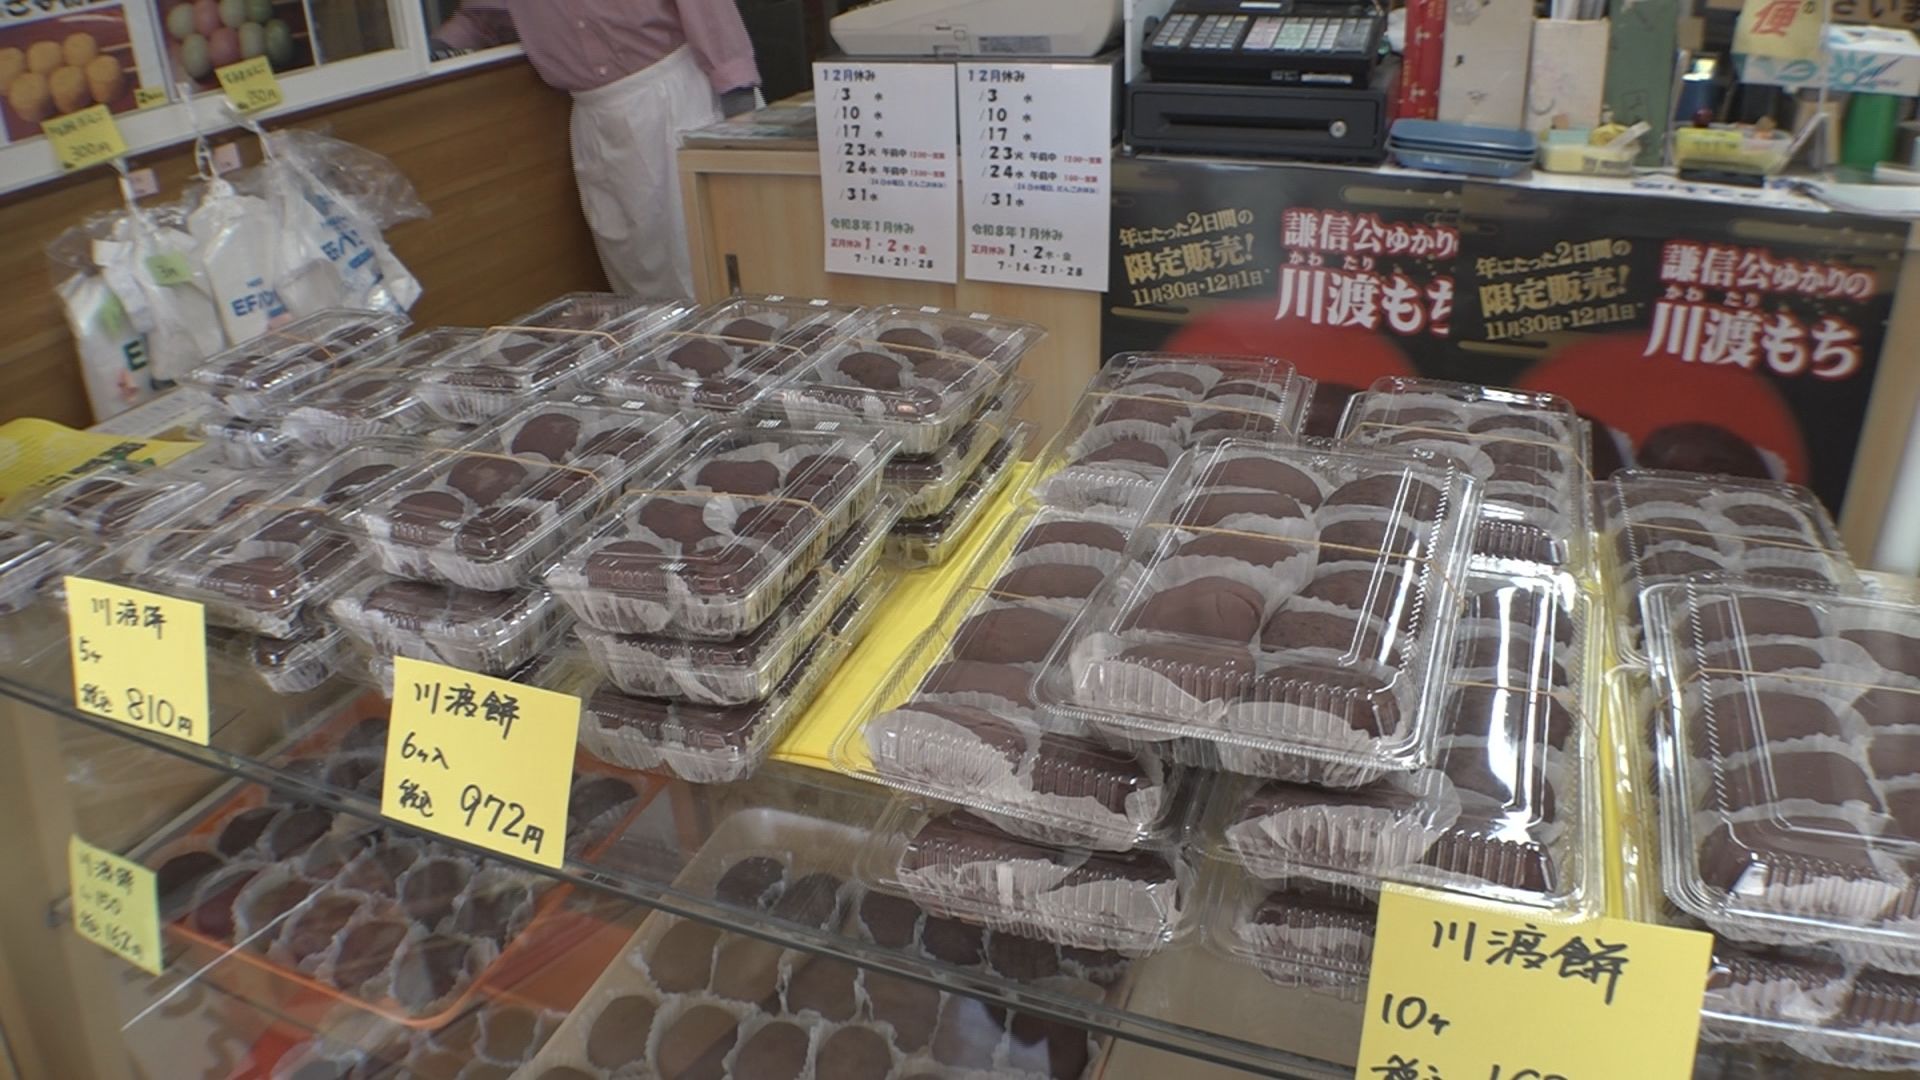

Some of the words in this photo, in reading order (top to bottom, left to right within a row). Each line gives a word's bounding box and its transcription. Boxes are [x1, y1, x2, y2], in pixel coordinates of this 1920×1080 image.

[823, 69, 876, 82] 12月休み
[968, 70, 1025, 82] 12月休み
[831, 218, 914, 234] 令和8年1月休み
[972, 224, 1064, 241] 令和8年1月休み
[1119, 208, 1254, 249] 年にたった2日間の
[1124, 233, 1255, 286] 限定販売!
[1476, 239, 1633, 278] 年にたった2日間の
[1662, 243, 1874, 298] 謙信公ゆかりの
[1132, 270, 1264, 306] 11月30日・12月1日
[1479, 265, 1630, 318] 限定販売!
[1485, 302, 1637, 340] 11月30日・12月1日
[1644, 302, 1862, 379] 川渡もち
[126, 687, 193, 736] 810円
[460, 784, 545, 855] 972円
[1432, 920, 1630, 1006] 川渡餅
